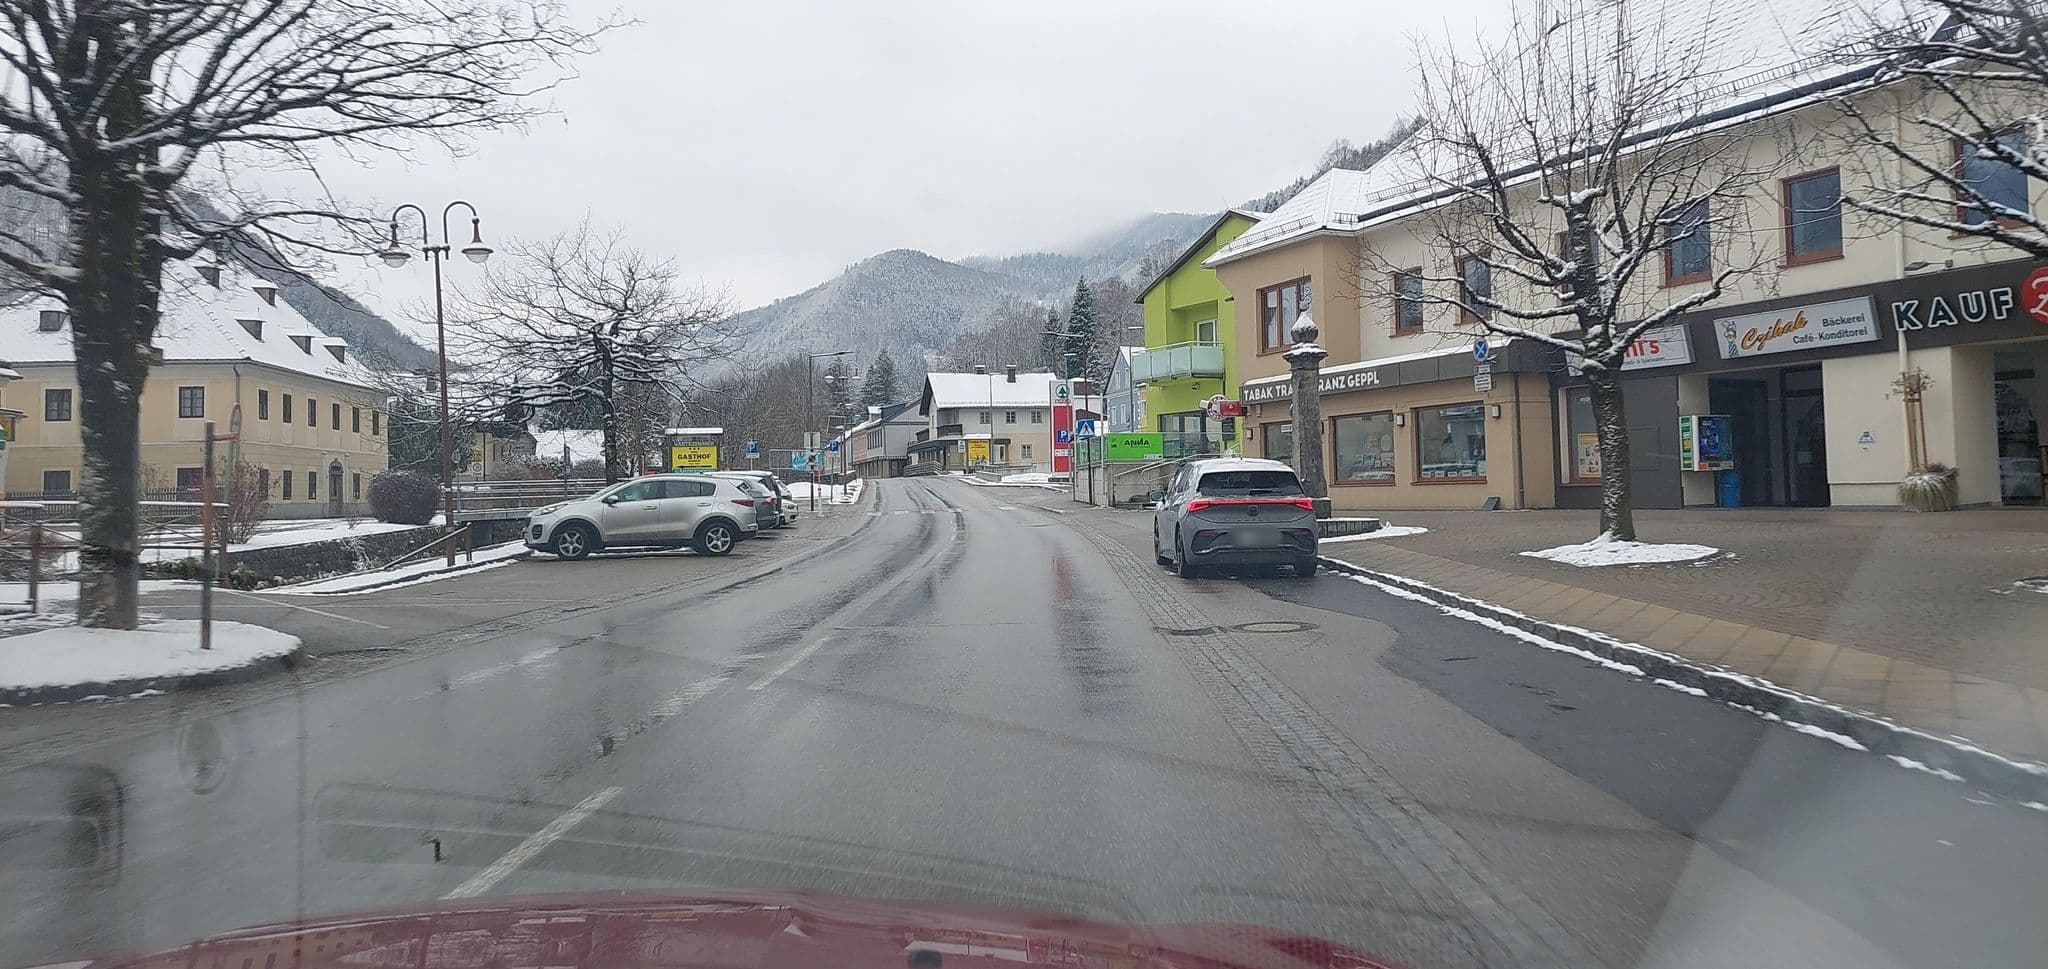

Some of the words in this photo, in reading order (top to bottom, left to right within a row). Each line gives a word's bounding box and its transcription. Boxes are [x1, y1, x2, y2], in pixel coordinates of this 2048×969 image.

[1822, 313, 1866, 328] Bäckerei
[1891, 286, 2014, 331] KAUF
[1741, 310, 1809, 351] Czihak
[1792, 326, 1868, 344] Café-Konditorei
[1243, 386, 1274, 402] TABAK
[1275, 383, 1294, 398] TRA
[1317, 375, 1346, 392] RANZ
[1347, 370, 1380, 388] GEPPL
